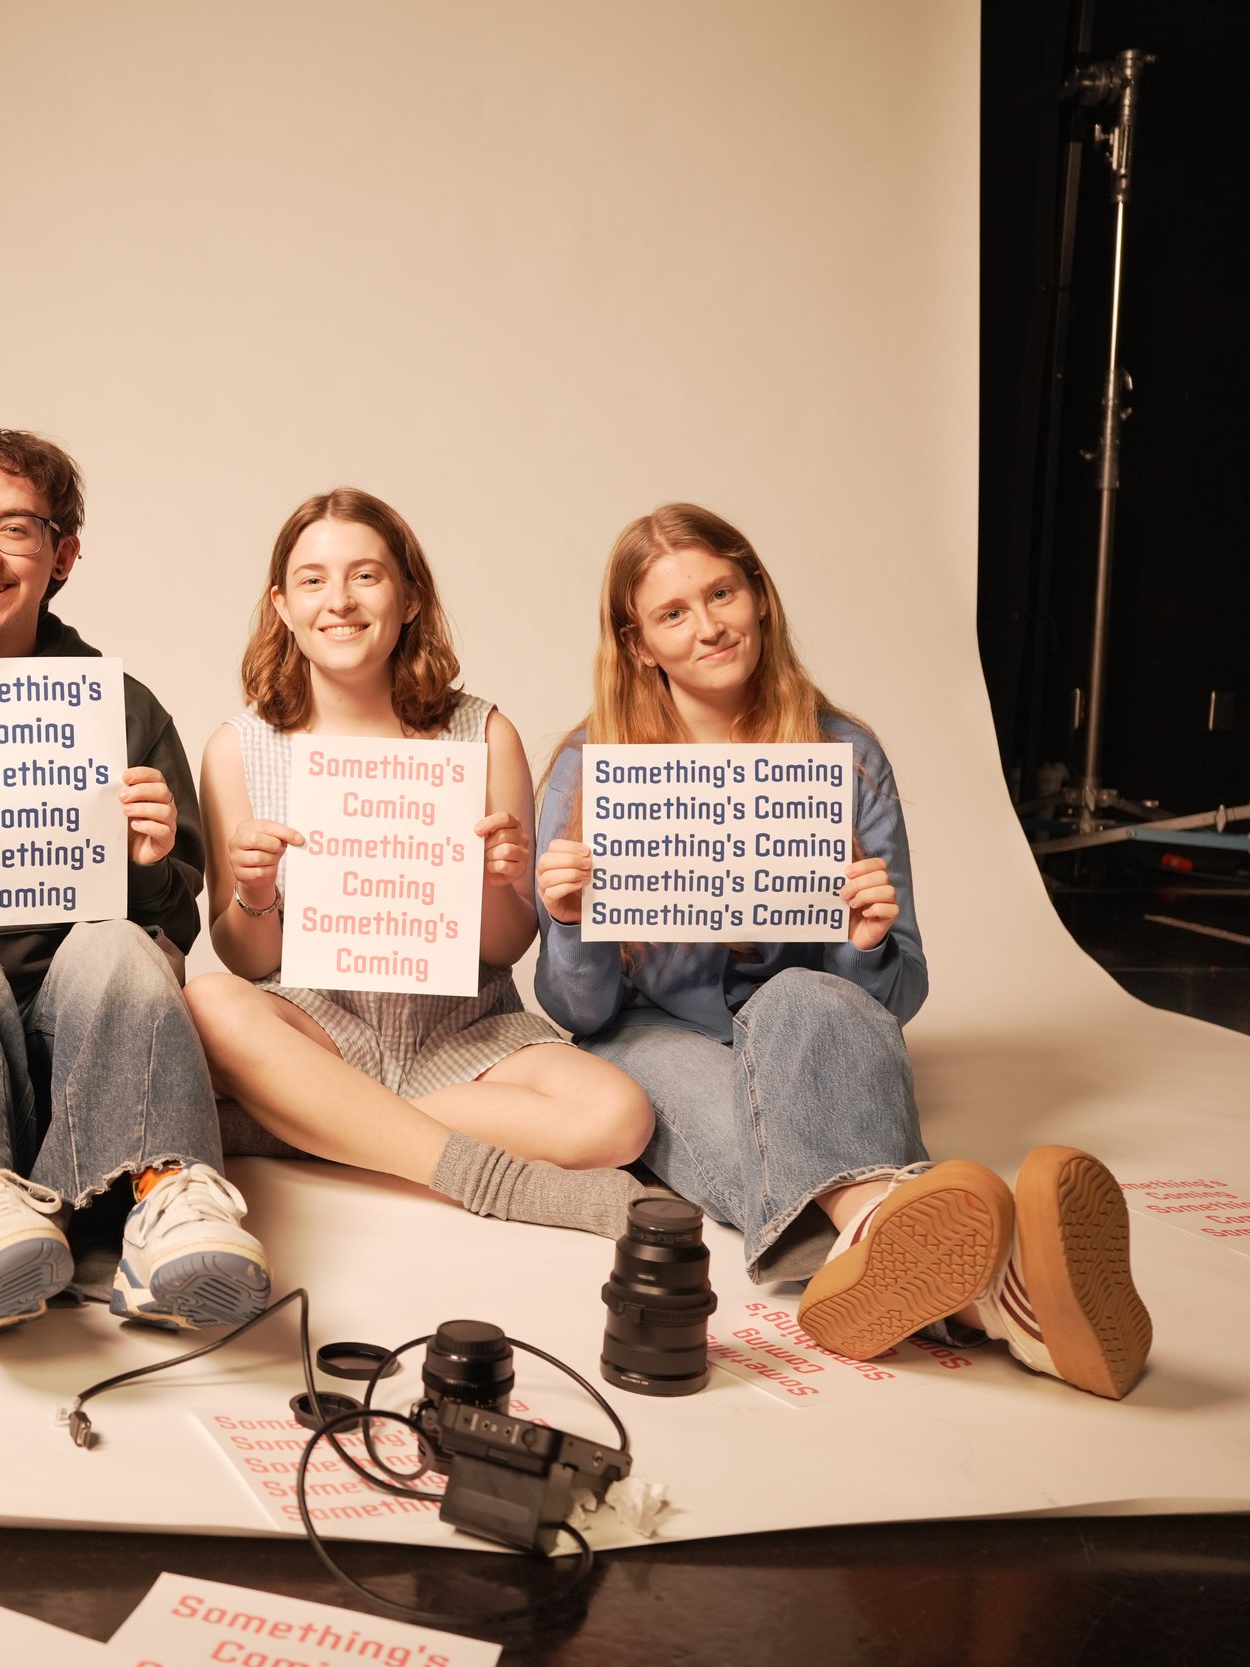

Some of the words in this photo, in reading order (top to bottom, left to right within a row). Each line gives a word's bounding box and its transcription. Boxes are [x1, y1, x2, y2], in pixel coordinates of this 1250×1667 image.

[309, 751, 464, 787] Something's
[596, 759, 745, 788] Something's
[754, 758, 843, 787] Coming
[343, 792, 435, 826] Coming
[596, 796, 745, 825] Something's
[754, 795, 842, 824] Coming
[308, 830, 465, 866] Something's
[592, 833, 745, 862] Something's
[755, 833, 845, 862] Coming
[343, 871, 435, 905] Coming
[592, 868, 745, 897] Something's
[754, 869, 845, 896] Coming
[302, 907, 458, 943] Something's
[592, 902, 743, 931] Something's
[753, 904, 843, 929] Coming
[336, 948, 428, 982] Coming
[1144, 1191, 1238, 1200] Coming
[732, 1327, 826, 1375] Coming
